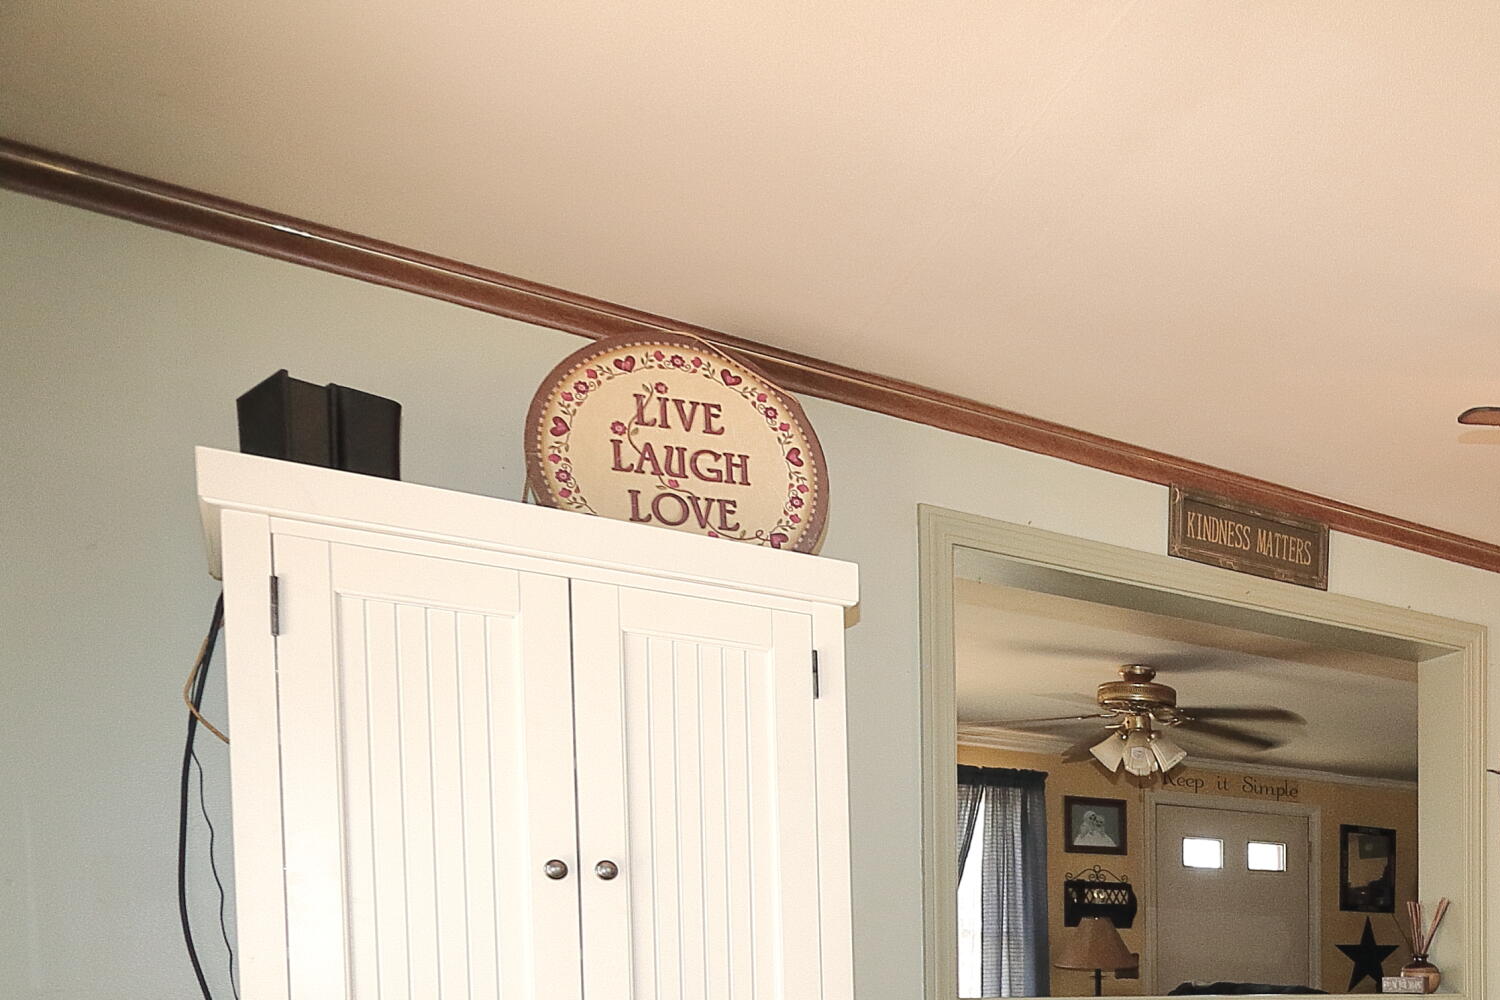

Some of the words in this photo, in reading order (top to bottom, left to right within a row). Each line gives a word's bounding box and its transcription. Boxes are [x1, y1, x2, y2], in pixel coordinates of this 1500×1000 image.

[633, 393, 725, 435] LIVE
[610, 439, 751, 486] LAUGH
[628, 489, 740, 531] LOVE
[1187, 511, 1251, 550] KINDNESS
[1256, 528, 1312, 566] MATTERS
[1162, 773, 1205, 793] Keep
[1217, 776, 1229, 791] it
[1242, 776, 1299, 801] Simple
